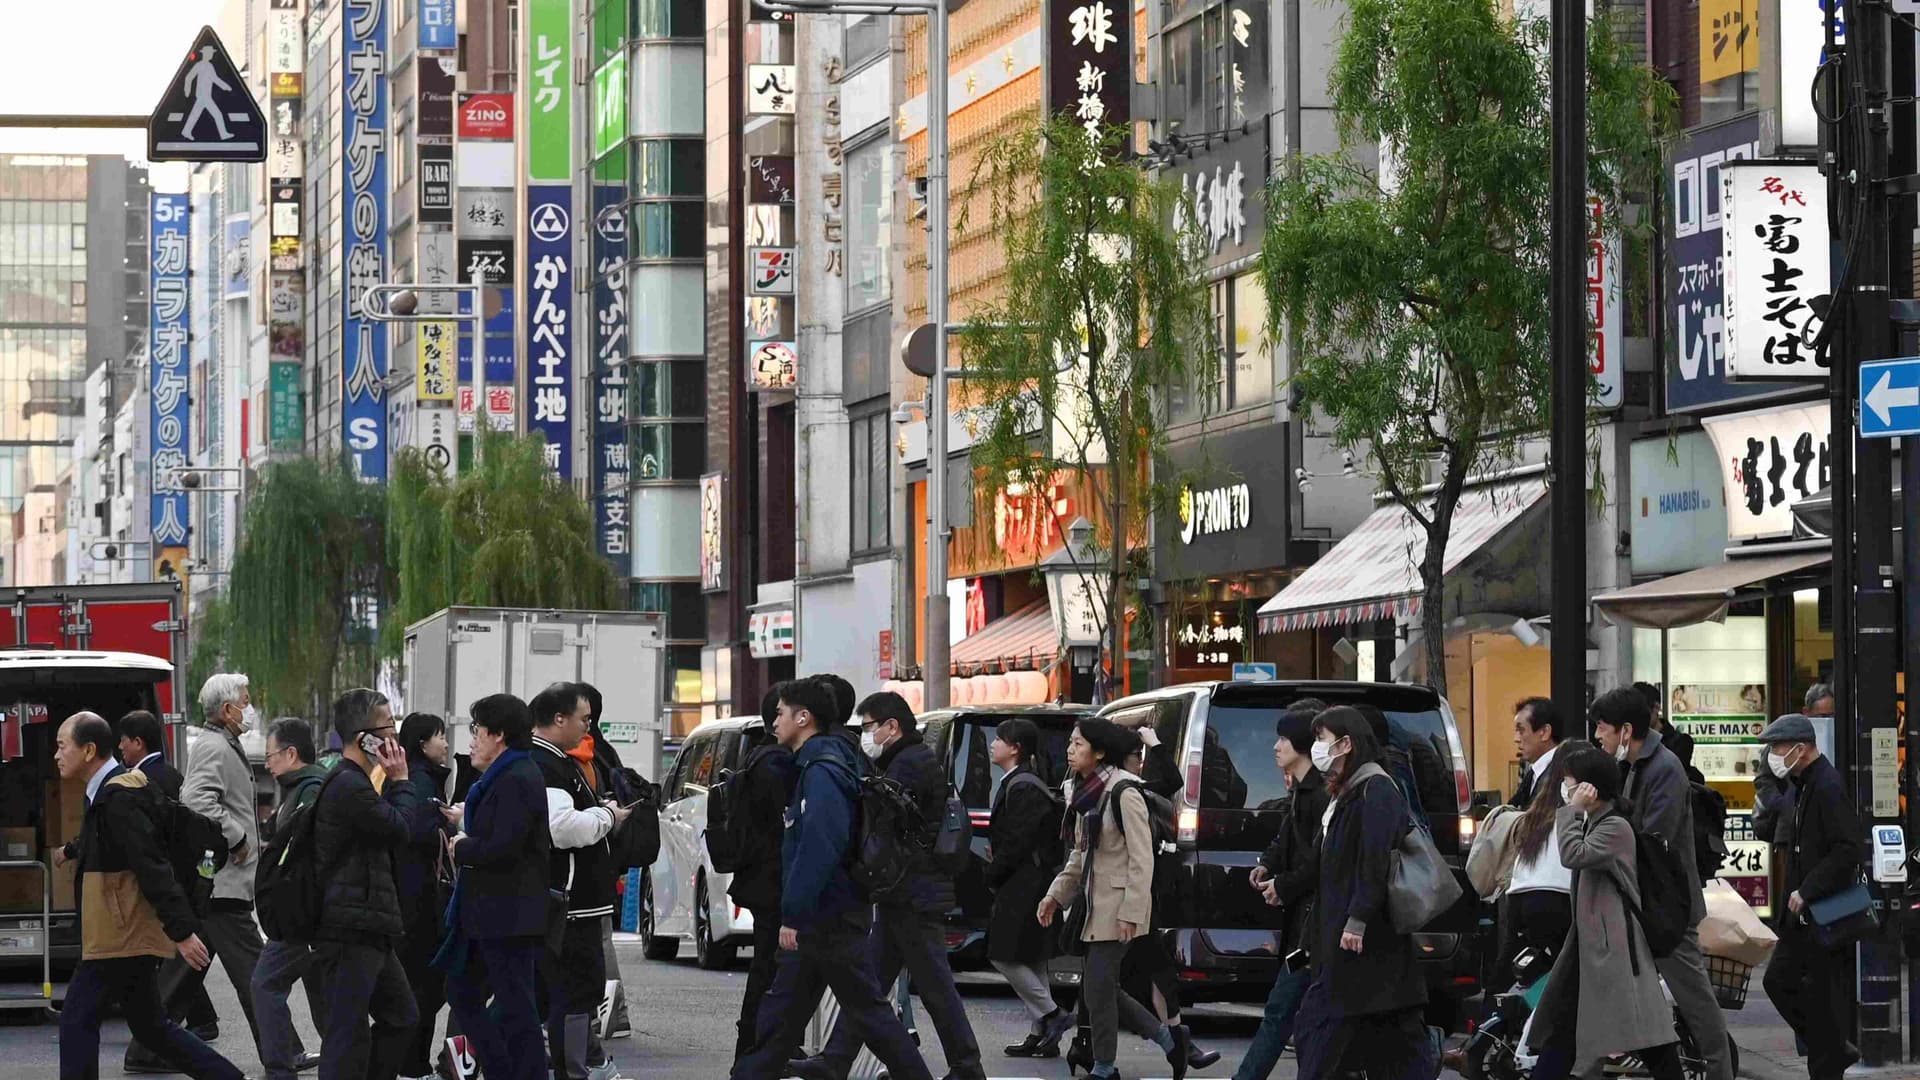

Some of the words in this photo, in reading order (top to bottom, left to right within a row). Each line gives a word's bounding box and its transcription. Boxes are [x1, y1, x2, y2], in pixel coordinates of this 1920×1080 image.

[534, 35, 561, 112] レイク
[466, 110, 506, 121] ZINO
[425, 165, 449, 182] BAR
[1760, 176, 1806, 206] 名代
[155, 197, 185, 222] 5F
[533, 255, 567, 422] かんべ土地
[153, 228, 188, 544] カラオケの鉄人
[1196, 483, 1249, 535] PRONTO
[1719, 723, 1749, 735] MAX
